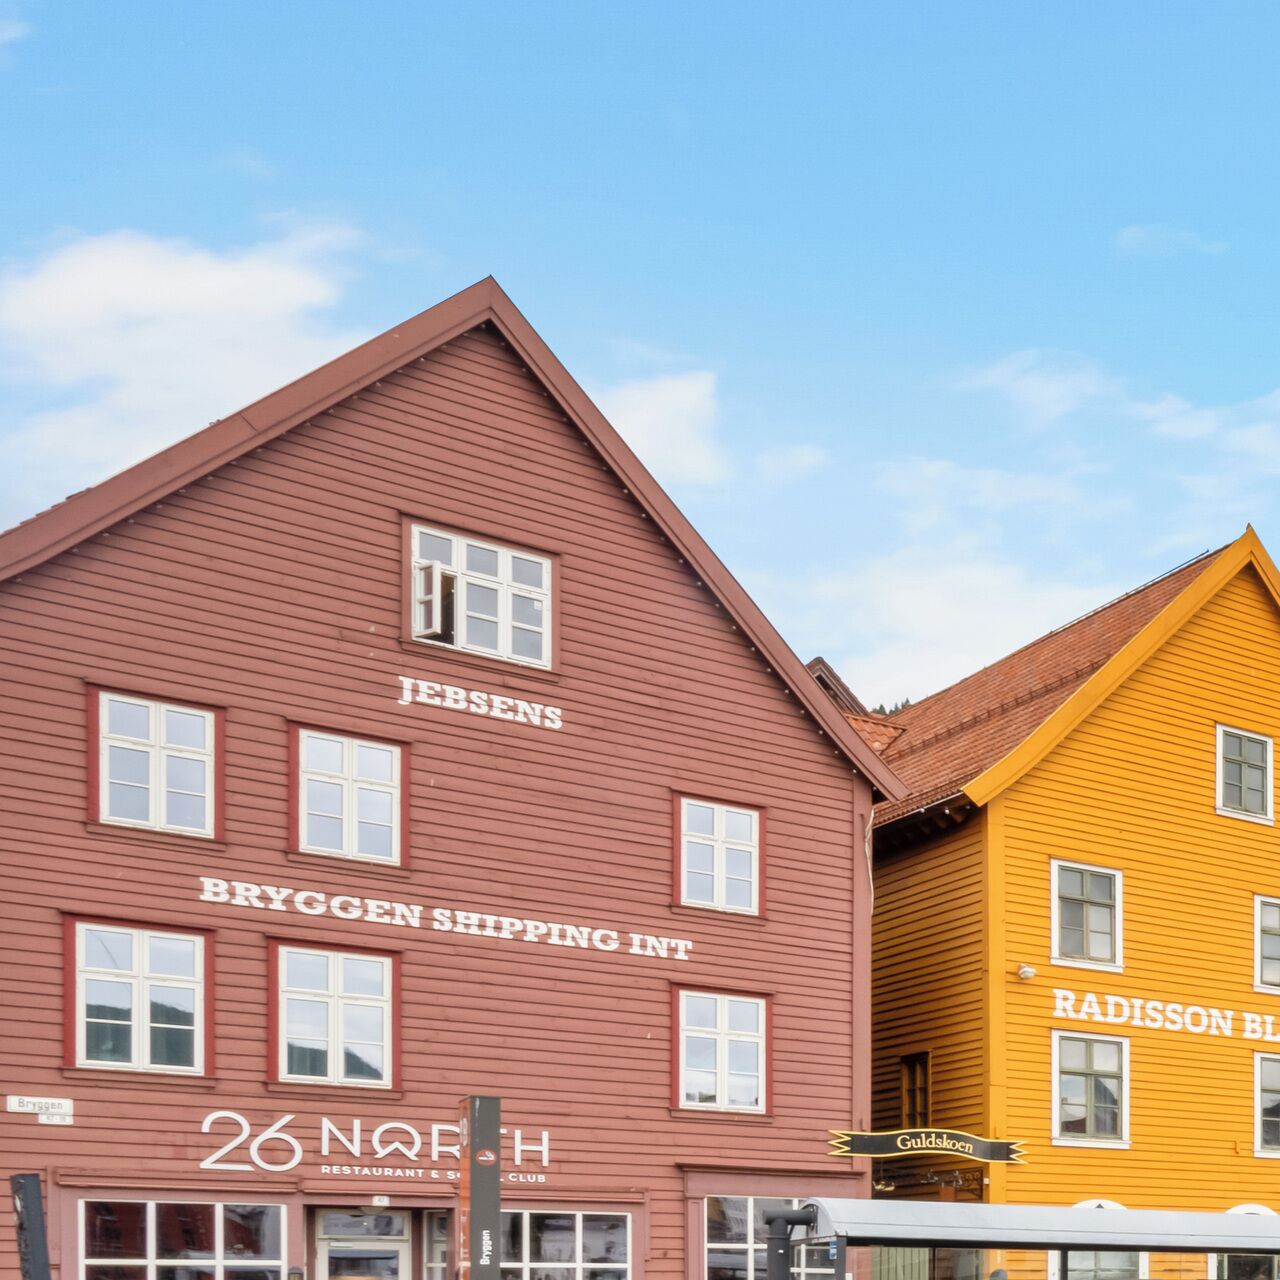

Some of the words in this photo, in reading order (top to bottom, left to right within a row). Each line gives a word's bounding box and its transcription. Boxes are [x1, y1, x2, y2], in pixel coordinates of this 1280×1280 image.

[397, 675, 563, 730] JEBSENS
[199, 877, 424, 928] BRYGGEN
[432, 907, 620, 951] SHIPPING
[628, 932, 693, 960] INT
[1052, 988, 1234, 1037] RADISSON
[18, 1098, 63, 1111] Bryggen
[199, 1111, 303, 1172] 26
[320, 1117, 550, 1168] NORH
[896, 1133, 974, 1153] Guldskoen
[321, 1165, 425, 1178] RESTAURANT
[431, 1170, 440, 1178] &
[508, 1173, 546, 1183] CLUB
[479, 1230, 491, 1265] Bryggen
